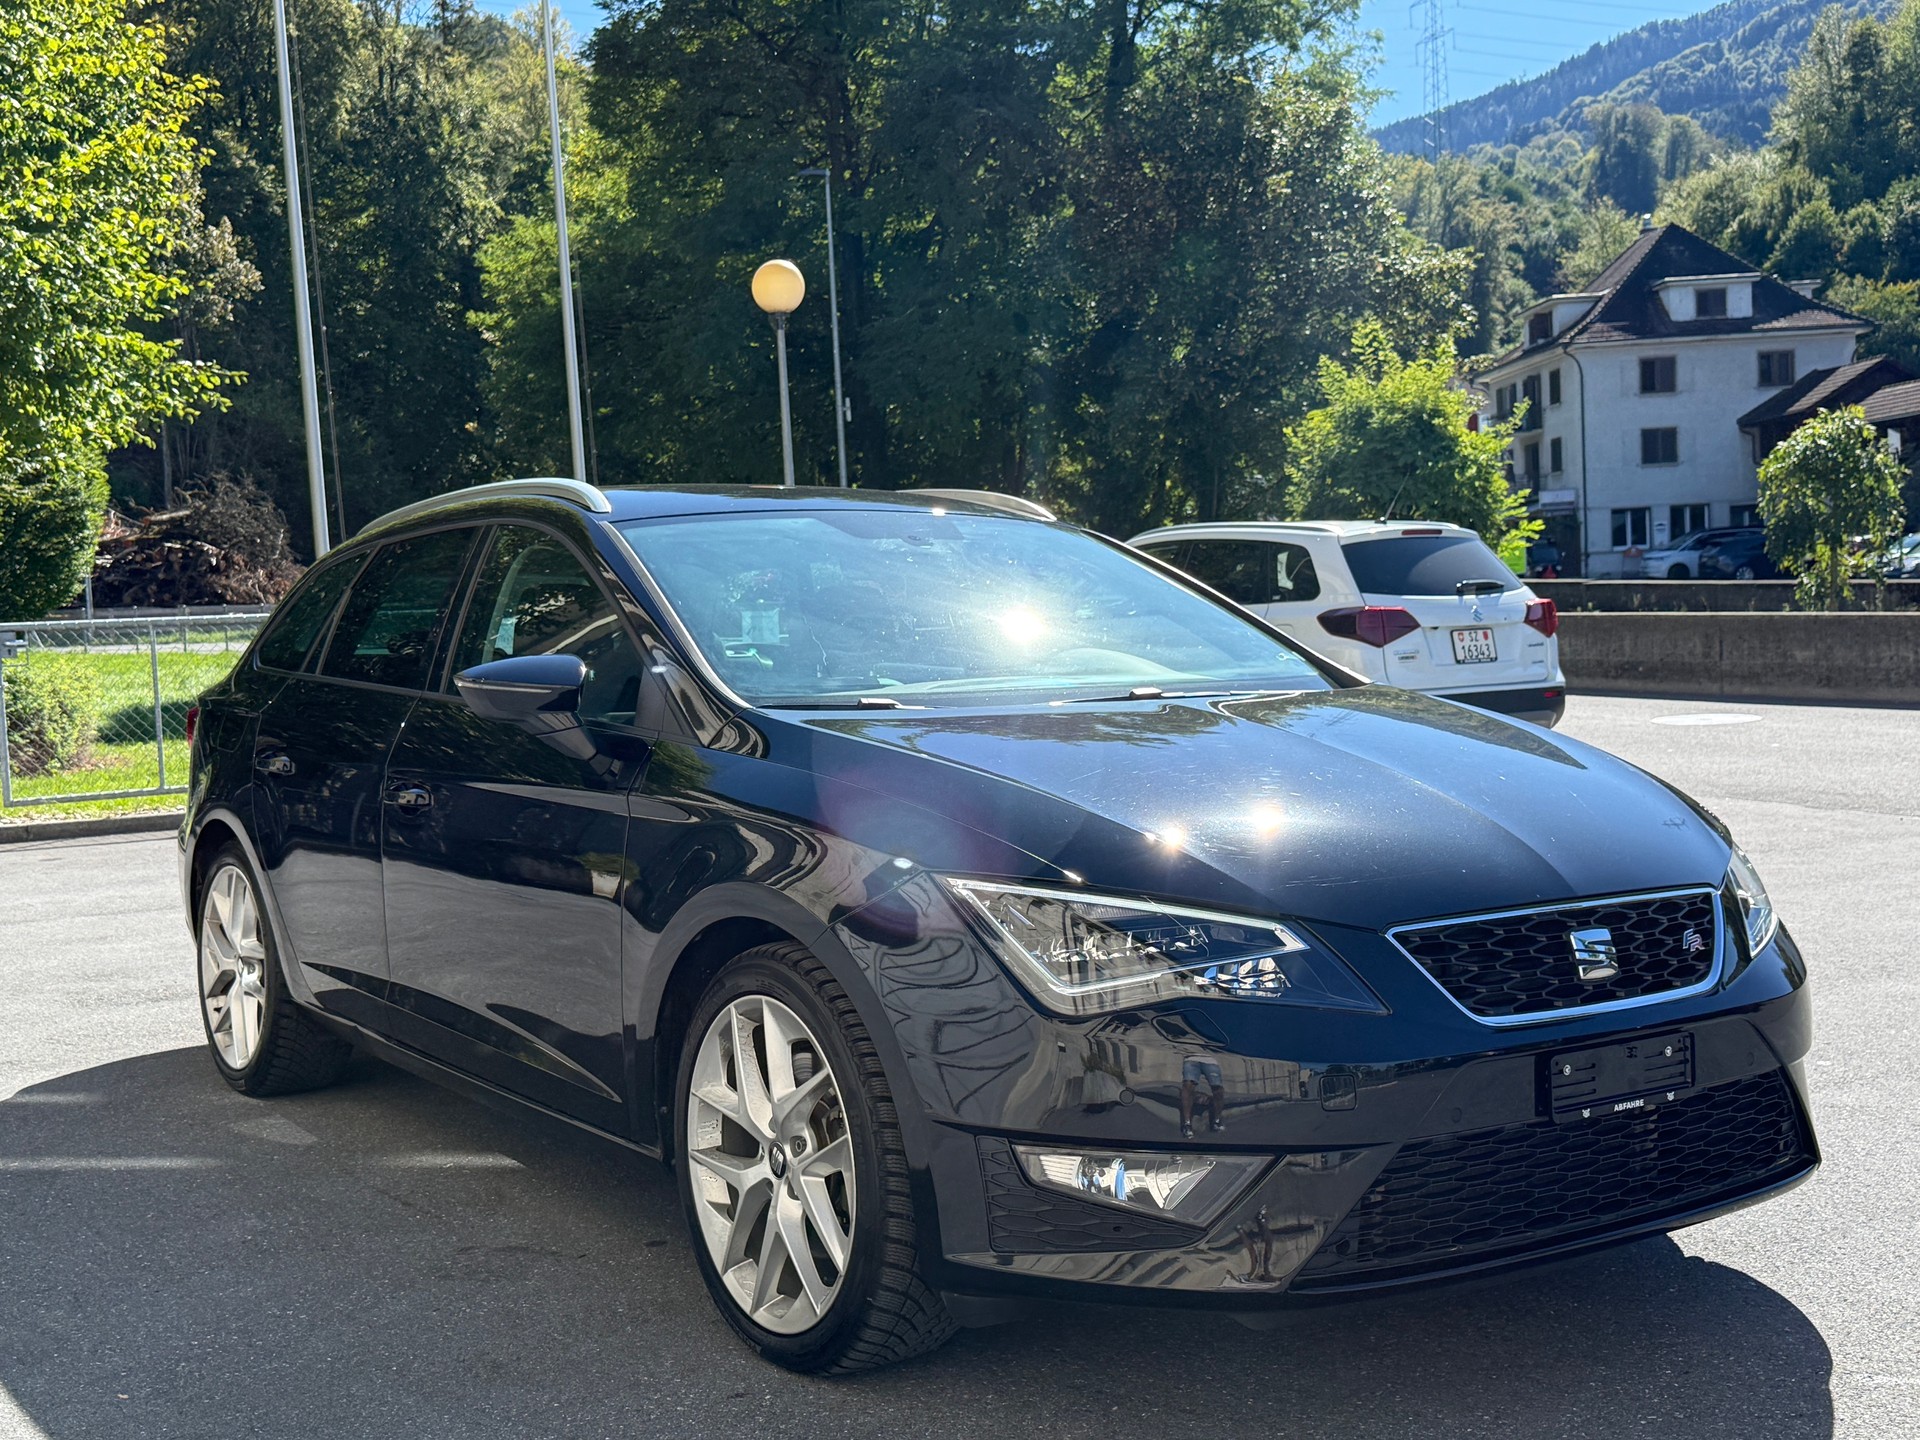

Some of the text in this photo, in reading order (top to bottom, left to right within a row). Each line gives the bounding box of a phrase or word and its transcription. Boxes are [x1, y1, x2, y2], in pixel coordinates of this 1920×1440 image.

[1468, 631, 1479, 642] SZ
[1461, 643, 1491, 659] 16343
[1614, 1099, 1645, 1112] ABFAHRE
